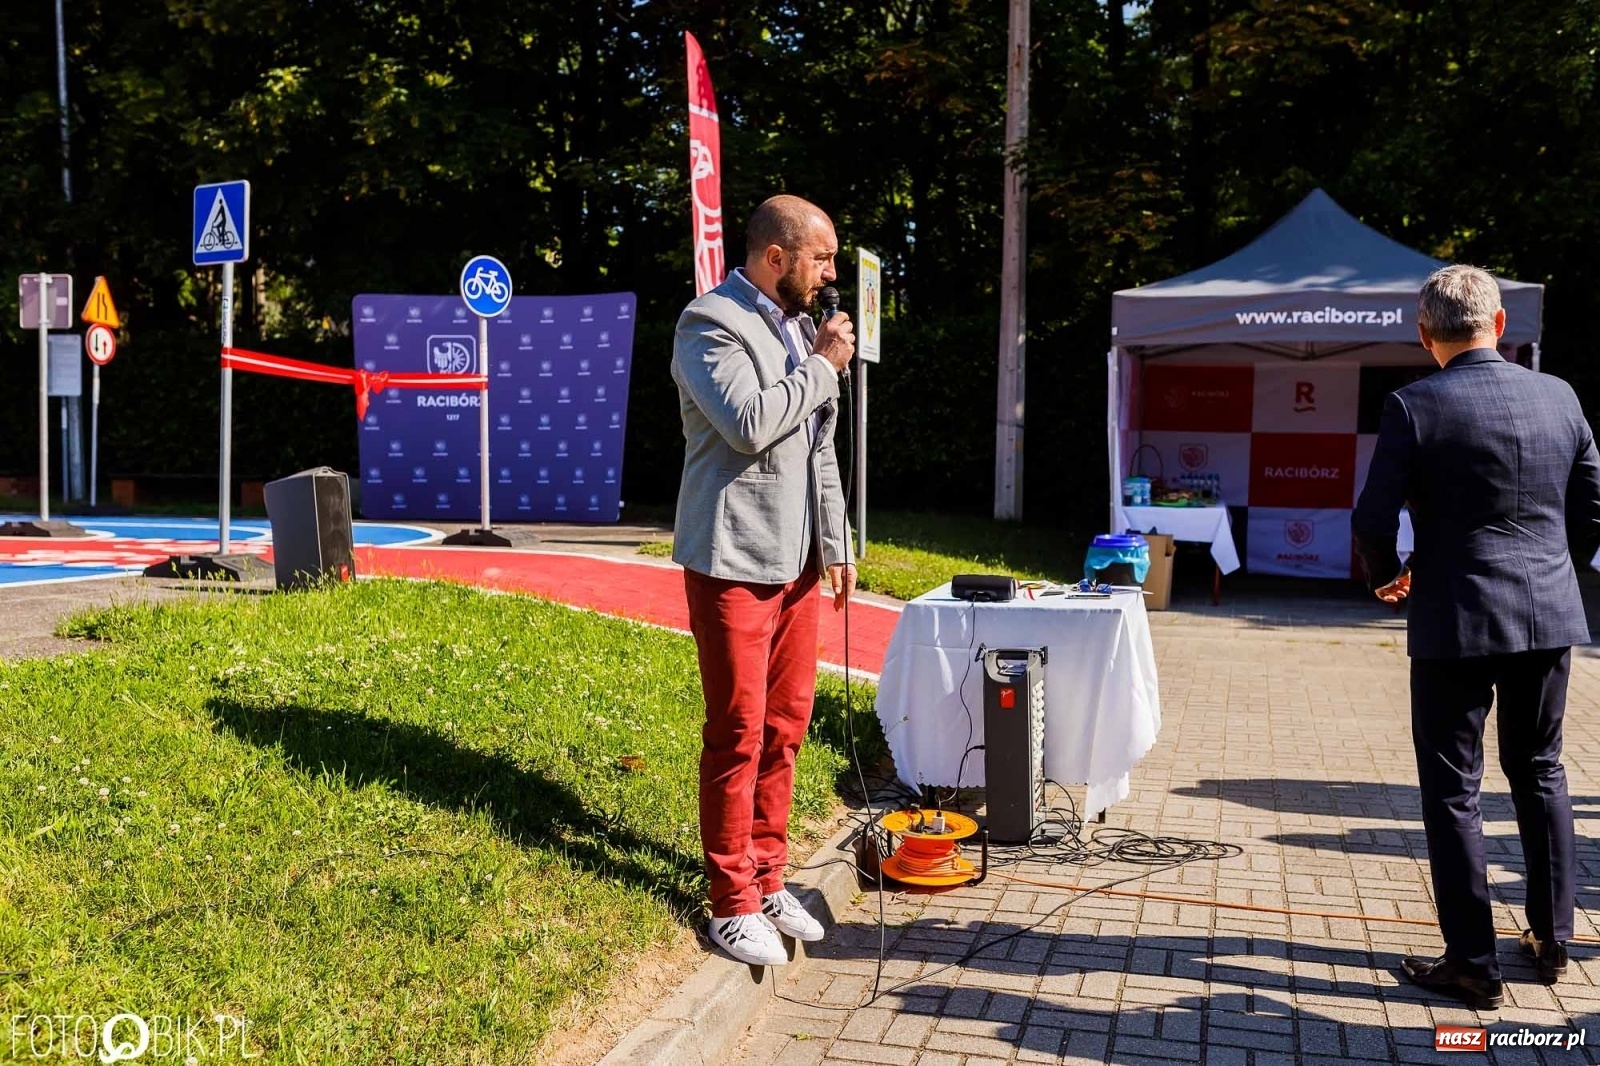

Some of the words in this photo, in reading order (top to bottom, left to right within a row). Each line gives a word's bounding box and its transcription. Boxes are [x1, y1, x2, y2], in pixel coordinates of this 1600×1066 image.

[1235, 306, 1403, 327] www.raciborz.pl
[1295, 382, 1315, 404] R
[1263, 465, 1341, 480] RACIBÓRZ
